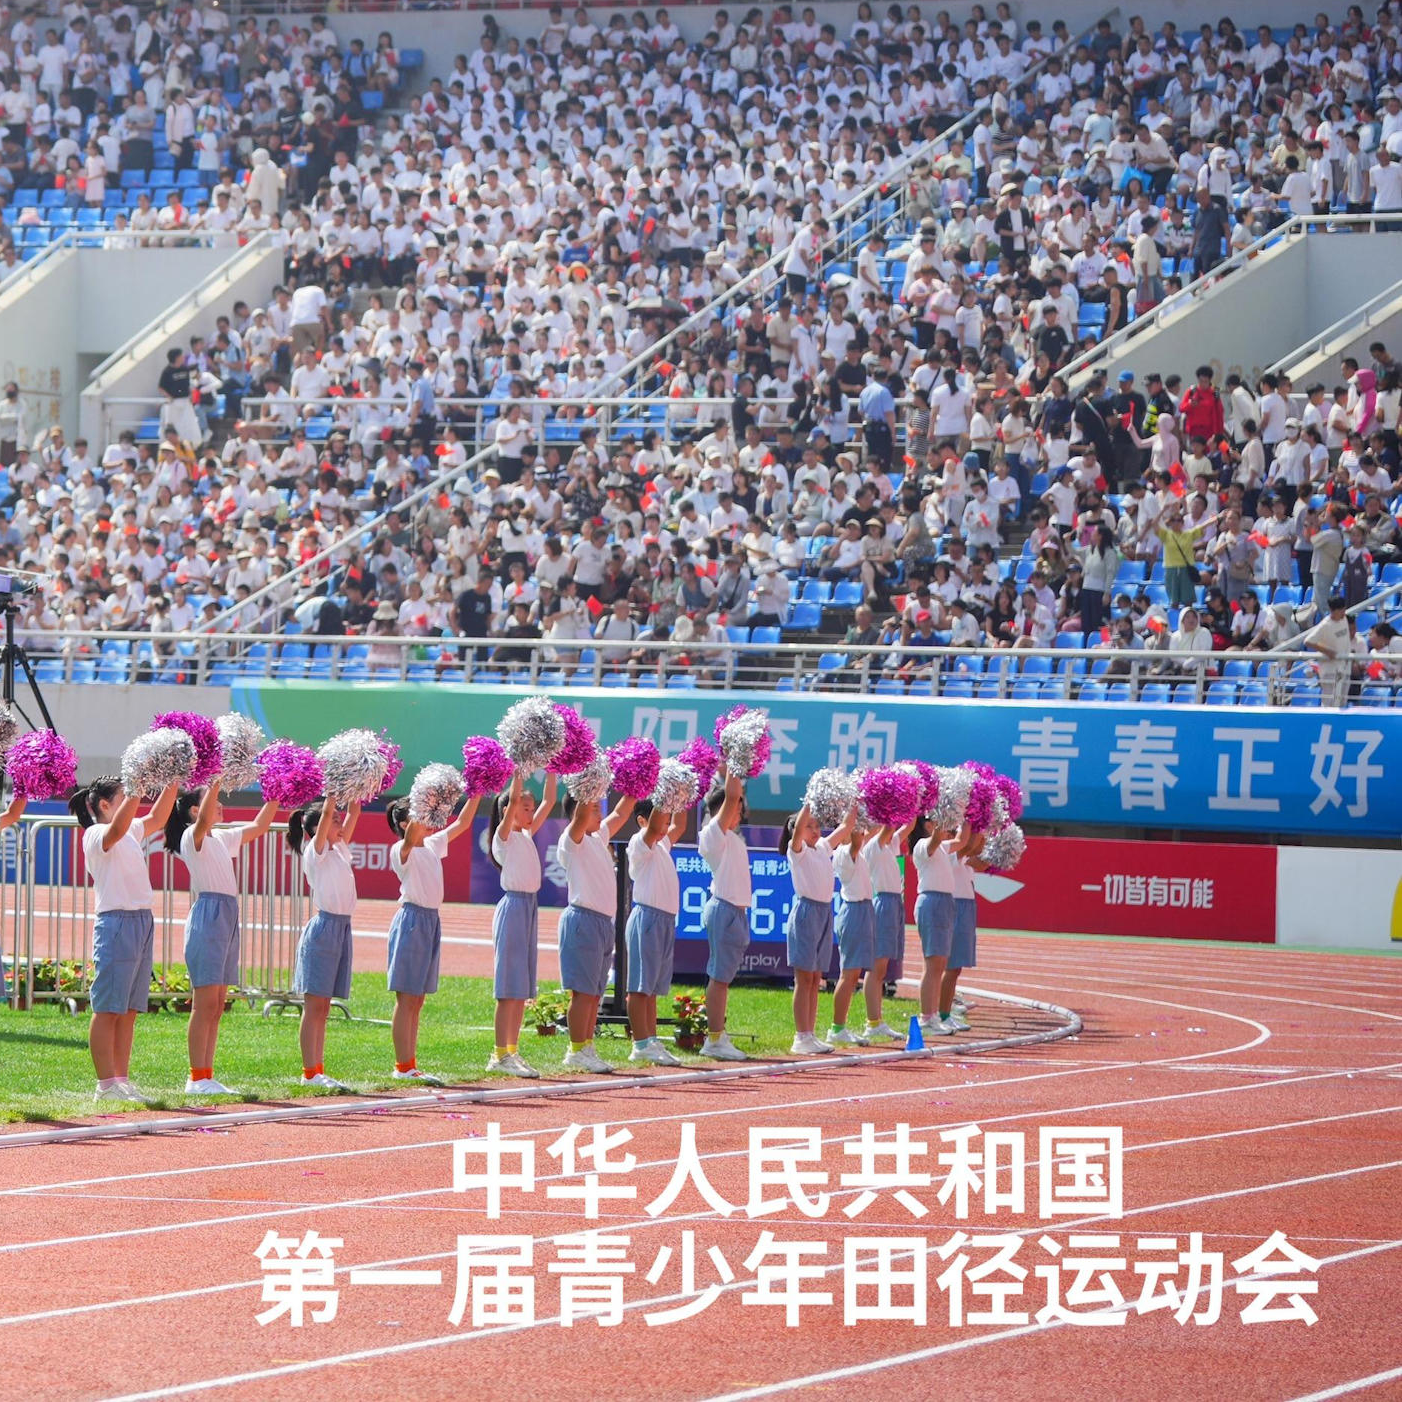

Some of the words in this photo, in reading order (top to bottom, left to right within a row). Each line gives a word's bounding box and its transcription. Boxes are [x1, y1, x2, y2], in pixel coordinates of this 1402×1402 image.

[1011, 716, 1385, 819] 青春正好
[1082, 873, 1214, 910] 一切皆有可能
